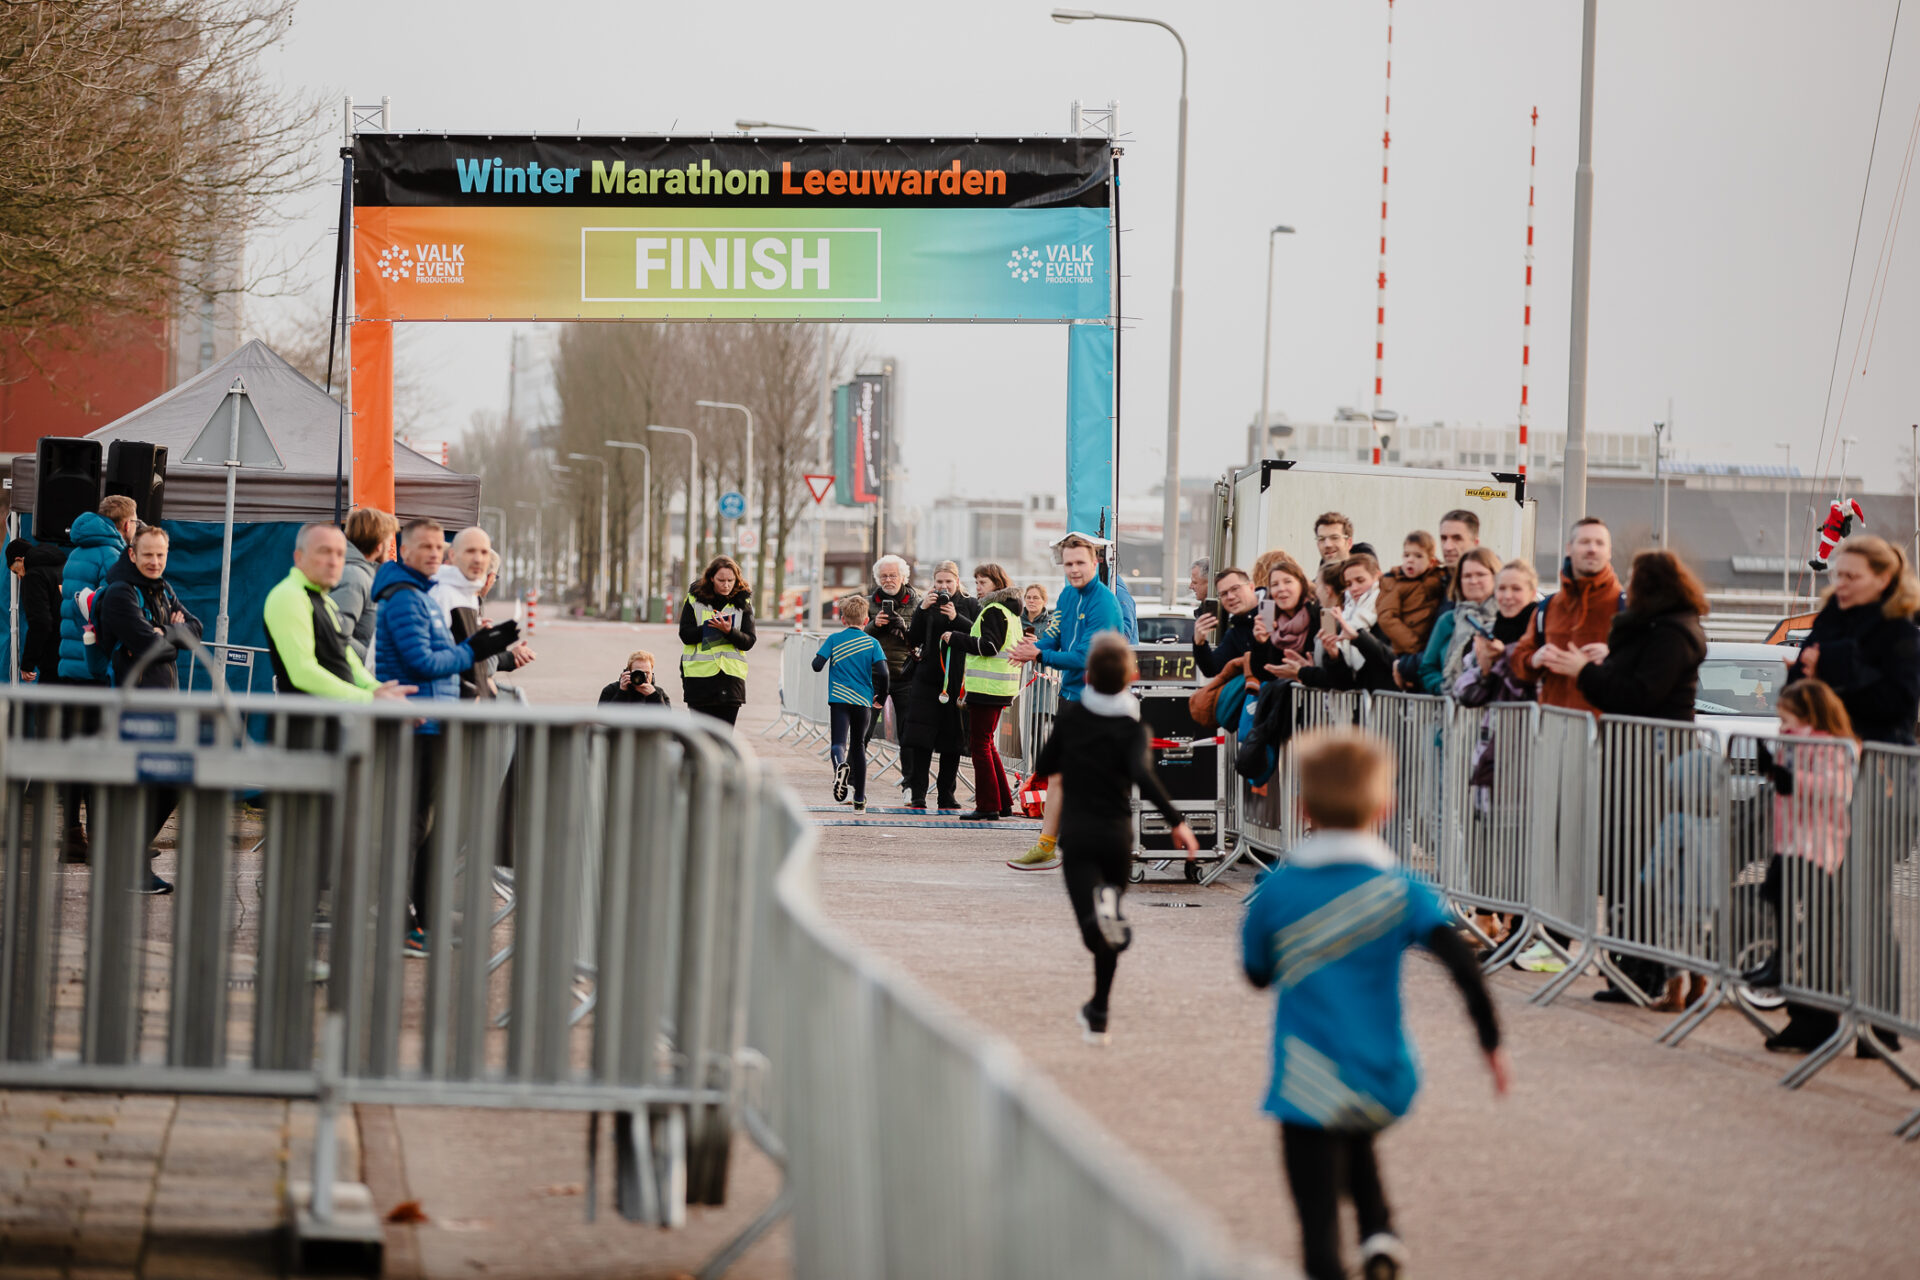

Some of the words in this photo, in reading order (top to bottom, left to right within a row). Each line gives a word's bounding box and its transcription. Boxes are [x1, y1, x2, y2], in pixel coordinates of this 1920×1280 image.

[456, 157, 580, 194] Winter
[591, 159, 770, 195] Marathon
[782, 159, 1007, 195] Leeuwarden
[416, 244, 465, 261] VALK
[1045, 244, 1094, 262] VALK
[416, 262, 465, 276] EVENT
[635, 237, 830, 290] FINISH
[1046, 262, 1094, 276] EVENT
[416, 276, 465, 284] PRODUCTIONS
[1045, 276, 1094, 284] PRODUCTIONS
